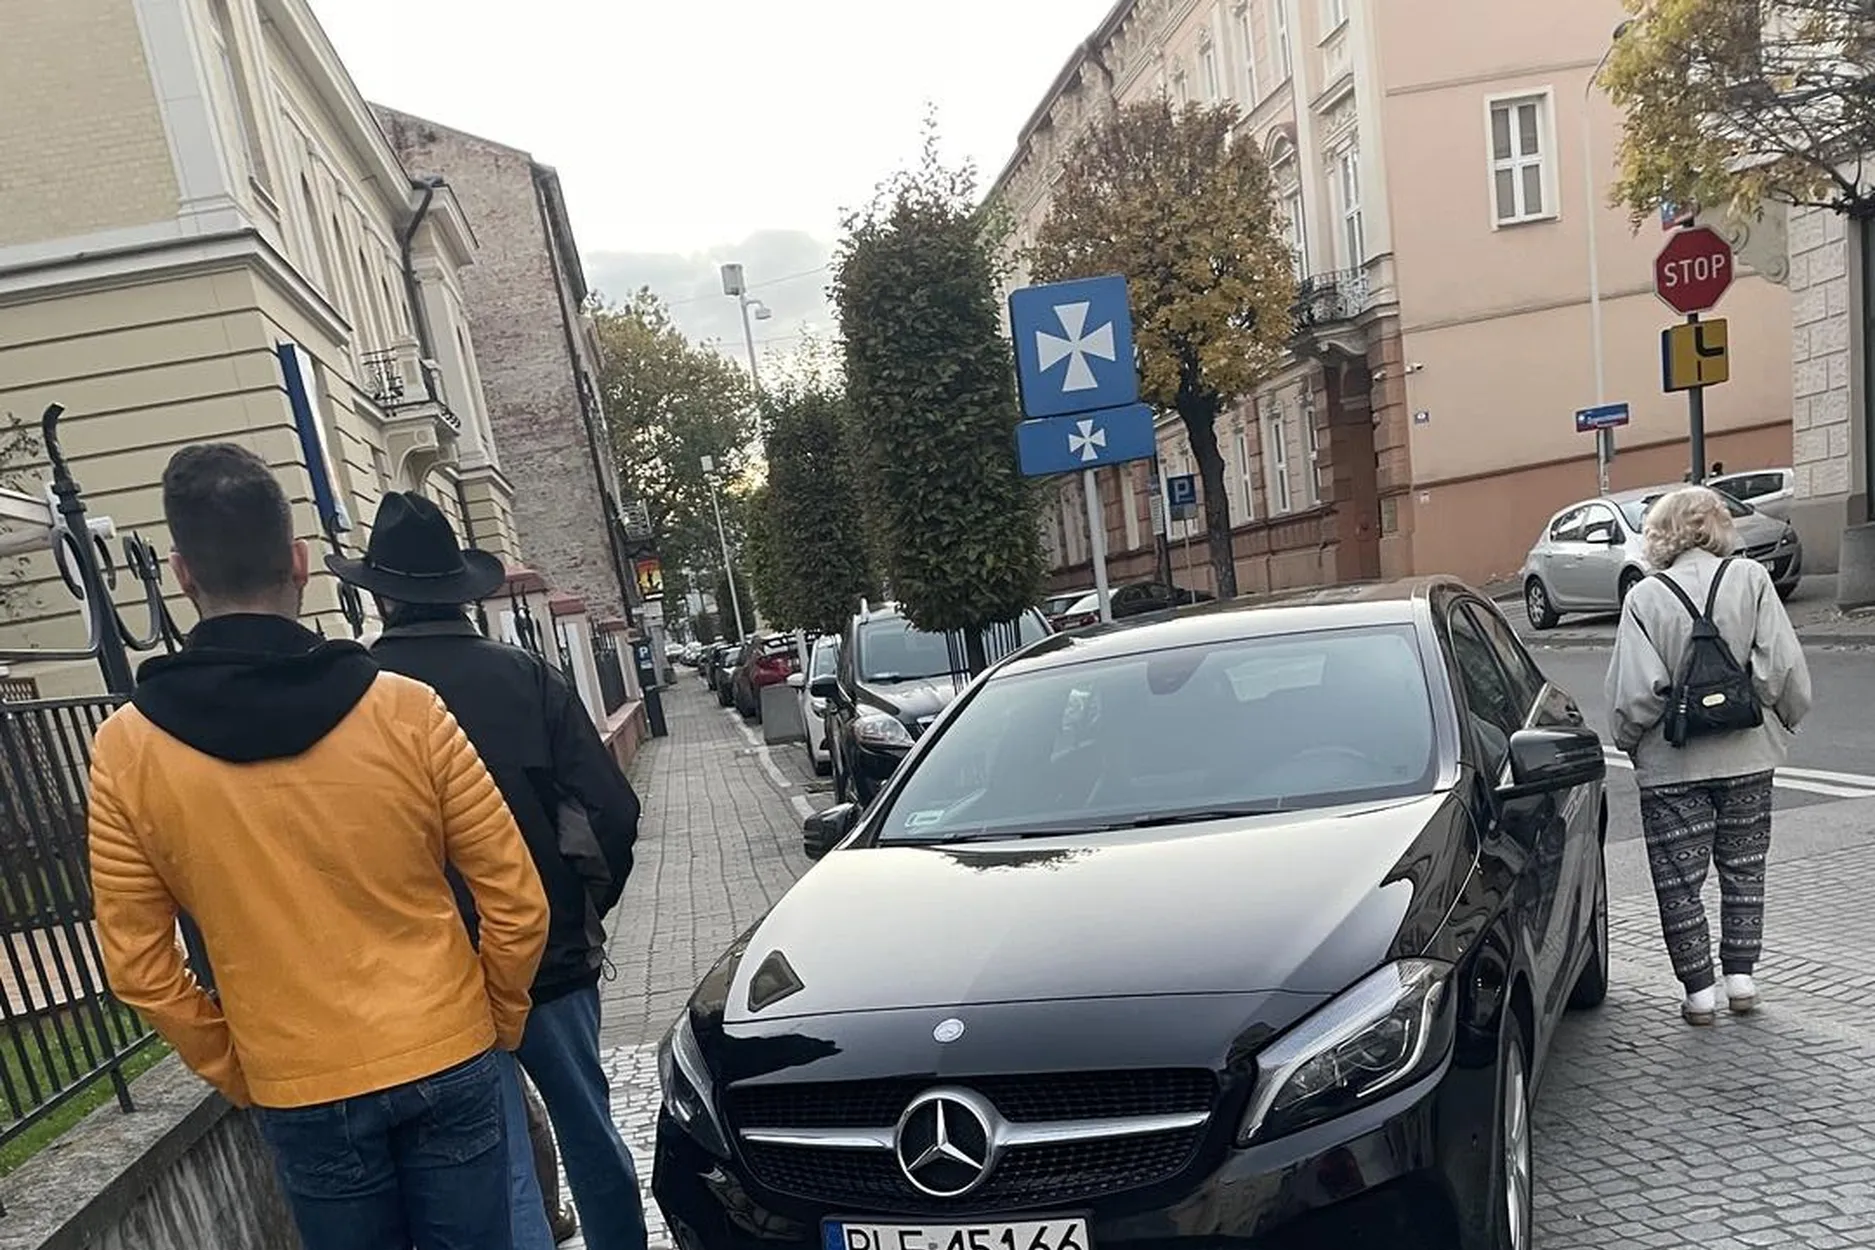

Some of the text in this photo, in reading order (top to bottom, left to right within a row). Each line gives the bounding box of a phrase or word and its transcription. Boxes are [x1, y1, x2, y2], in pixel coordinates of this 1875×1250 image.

[1664, 254, 1725, 287] STOP
[1174, 479, 1190, 503] P
[639, 646, 649, 659] P
